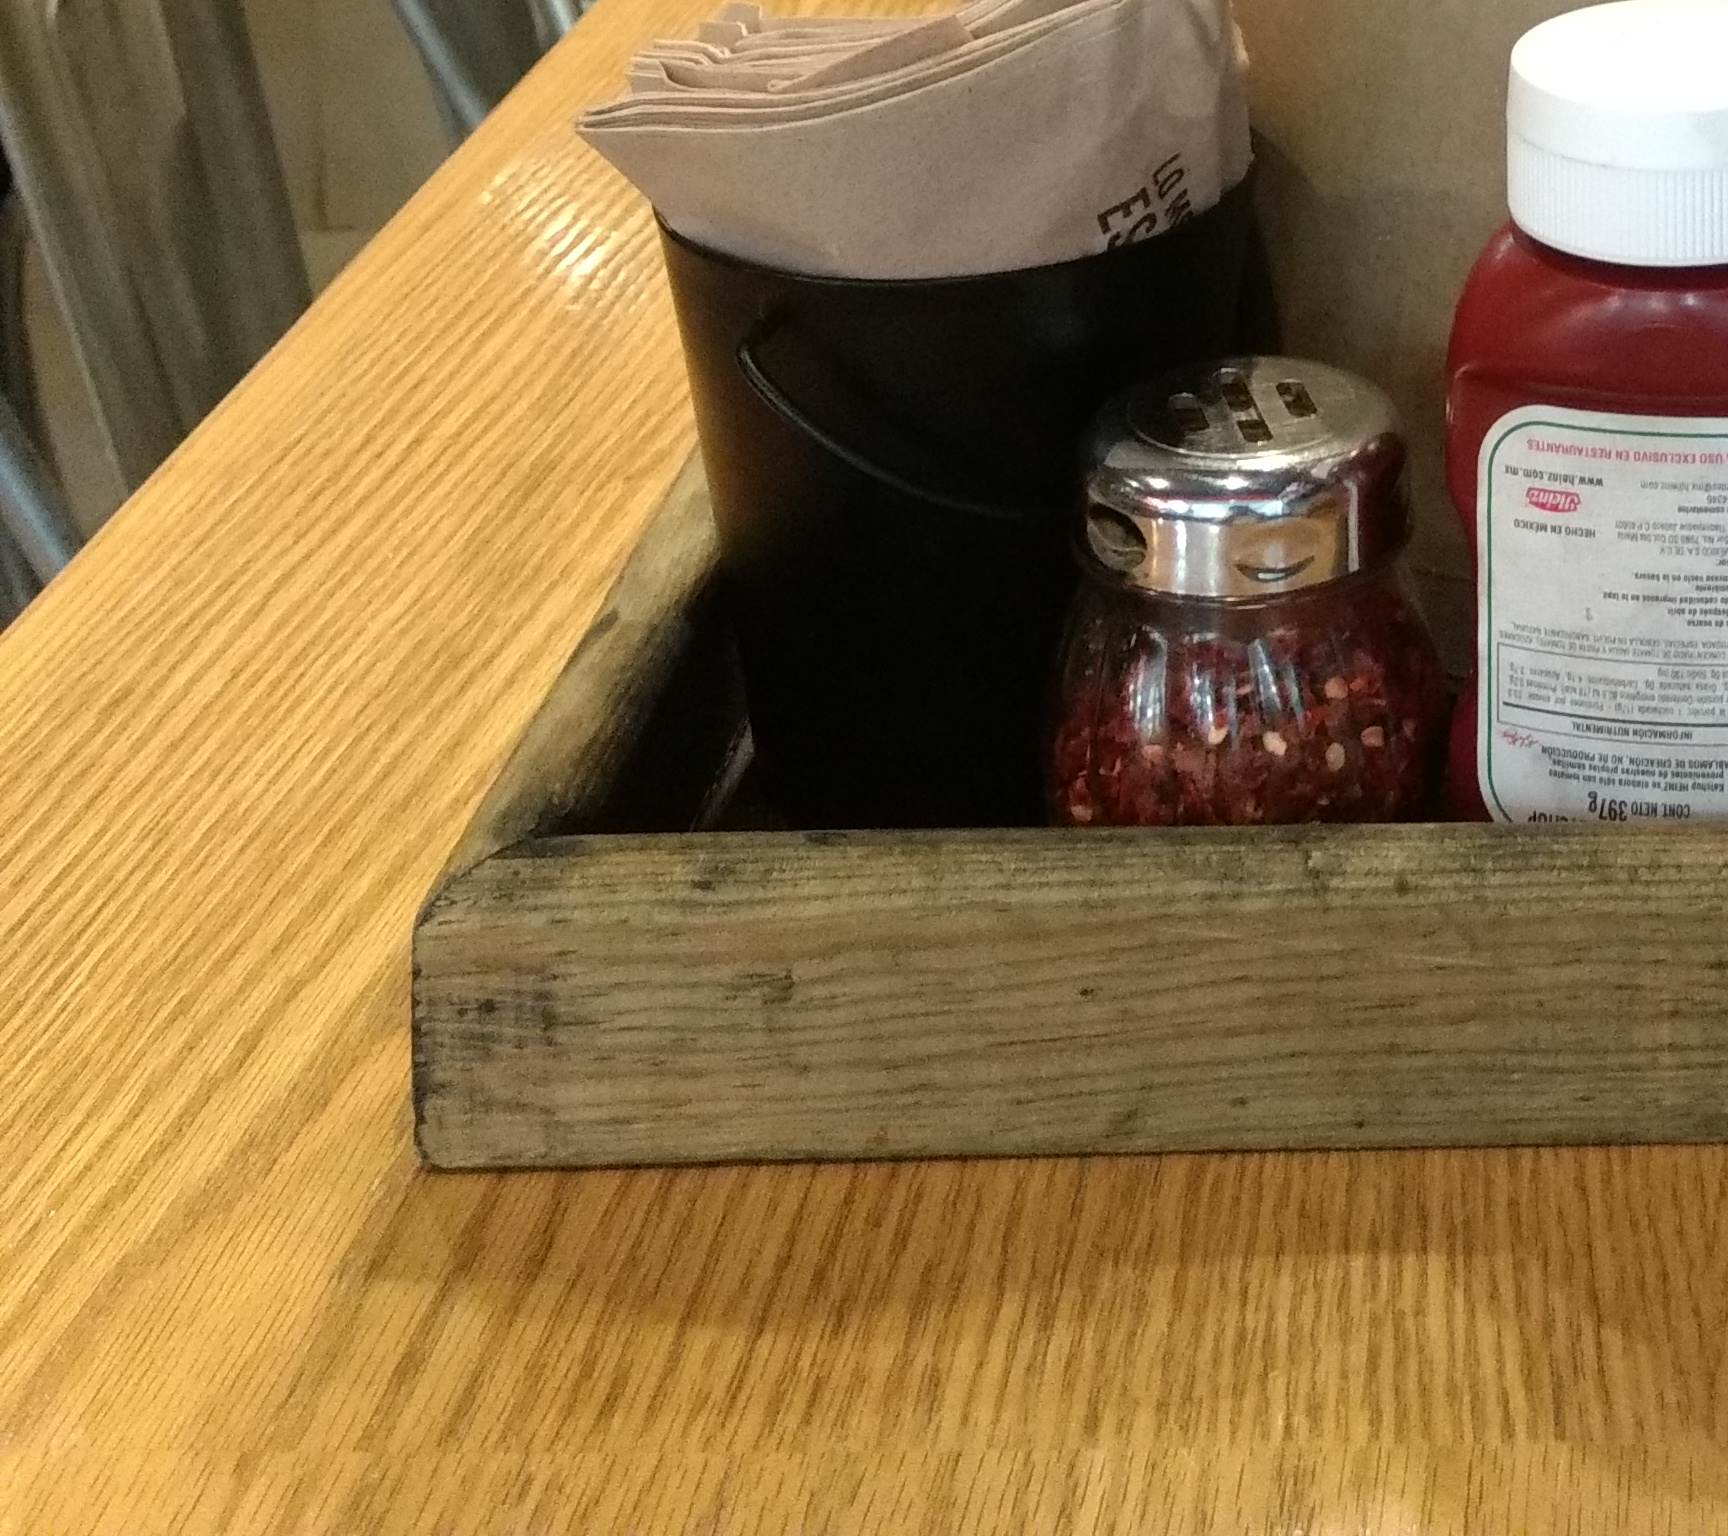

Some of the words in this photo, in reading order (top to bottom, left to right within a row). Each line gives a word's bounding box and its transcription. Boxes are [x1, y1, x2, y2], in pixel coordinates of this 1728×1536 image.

[1526, 439, 1612, 460] RESTAURANTES
[1615, 449, 1631, 462] EN
[1633, 450, 1696, 465] EXCLUSIVO
[1699, 452, 1723, 465] USO
[1504, 465, 1604, 488] www.heinz.com.mx
[1528, 489, 1579, 512] Heinz
[1513, 518, 1548, 535] MÉXICO
[1550, 523, 1563, 536] EN
[1564, 526, 1596, 539] HECHO
[1570, 721, 1630, 738] NUTRIMENTAL
[1632, 728, 1693, 741] INFORMACIÓN
[1597, 752, 1609, 763] DE
[1611, 754, 1624, 766] NO
[1675, 758, 1686, 769] DE
[1587, 790, 1629, 823] 397g
[1630, 801, 1658, 818] NETO
